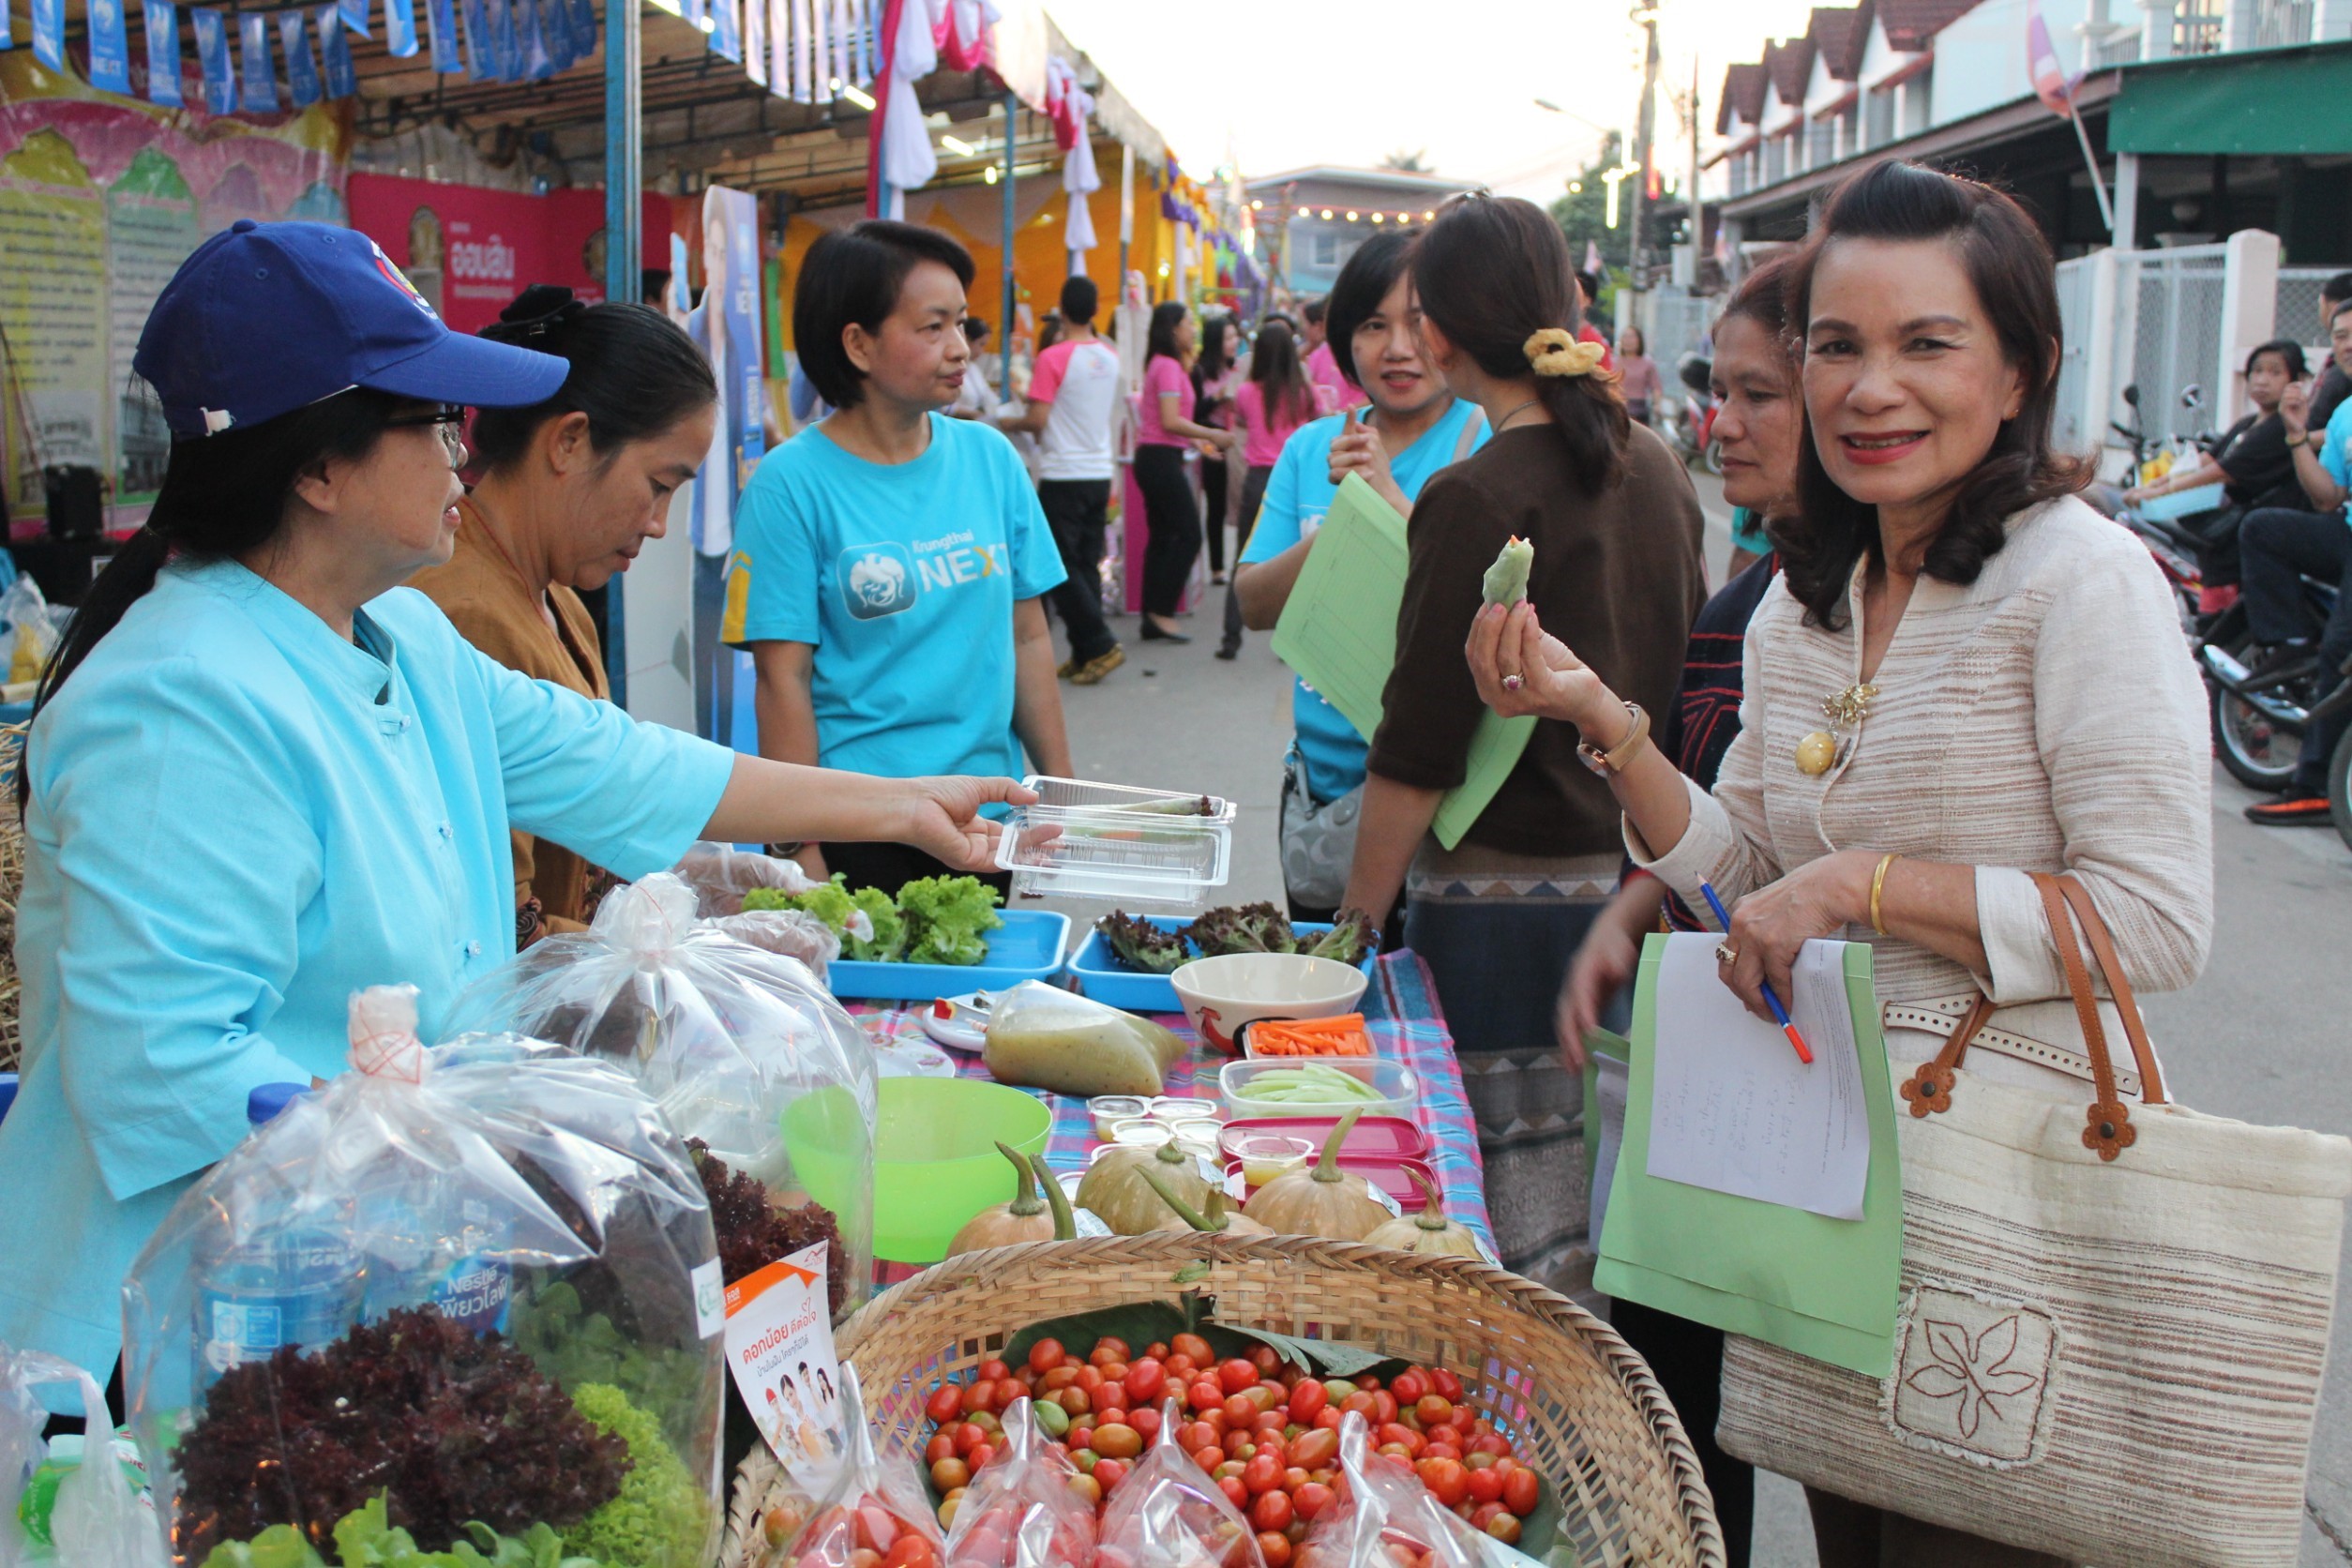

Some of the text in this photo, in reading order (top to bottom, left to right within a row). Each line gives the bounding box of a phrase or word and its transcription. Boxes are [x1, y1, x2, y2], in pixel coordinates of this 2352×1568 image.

[912, 528, 974, 553] Krungthai
[916, 544, 1007, 593] NEX
[436, 1276, 508, 1319] พียวไลฟ์
[446, 1262, 498, 1295] Nestlé
[743, 1323, 789, 1364] ดอกน้อย
